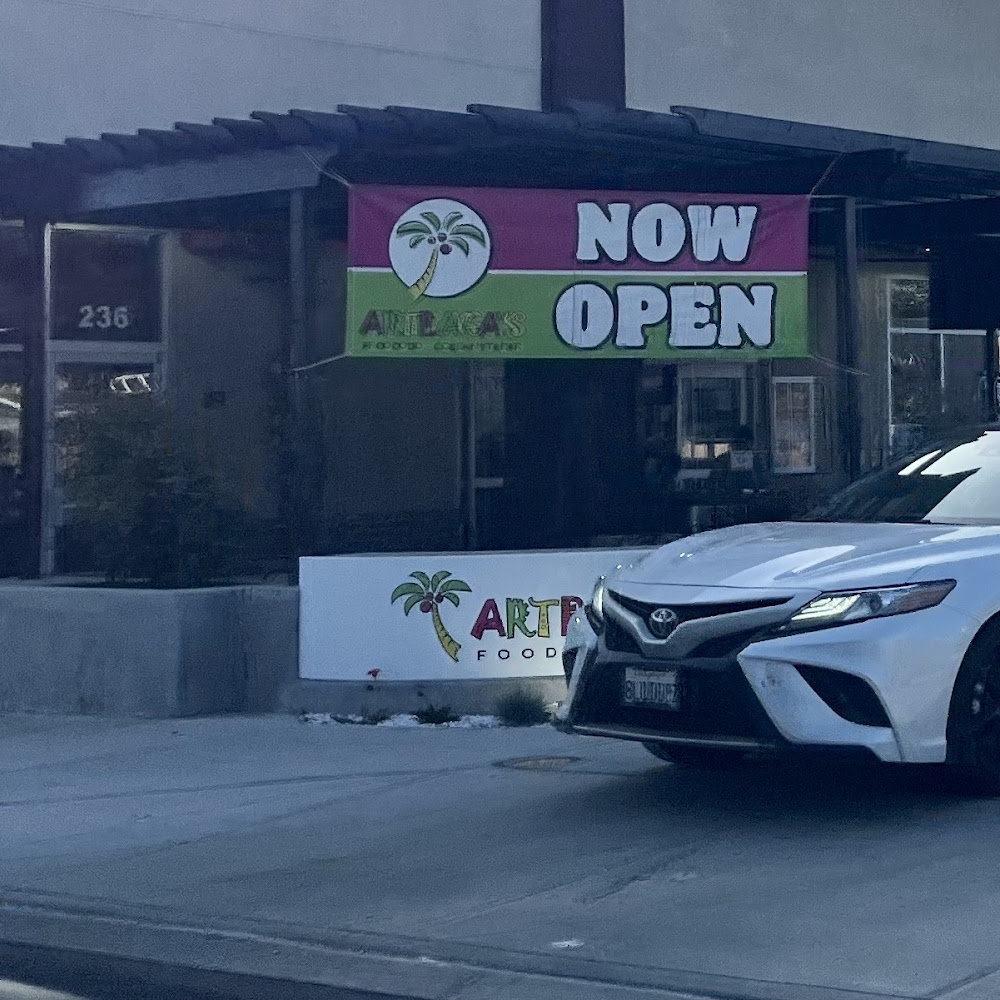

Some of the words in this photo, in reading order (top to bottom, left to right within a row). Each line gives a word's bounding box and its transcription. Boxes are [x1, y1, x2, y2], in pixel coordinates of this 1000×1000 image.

[575, 201, 758, 263] NOW
[78, 304, 130, 329] 236
[554, 281, 777, 350] OPEN
[476, 647, 558, 661] FOOD
